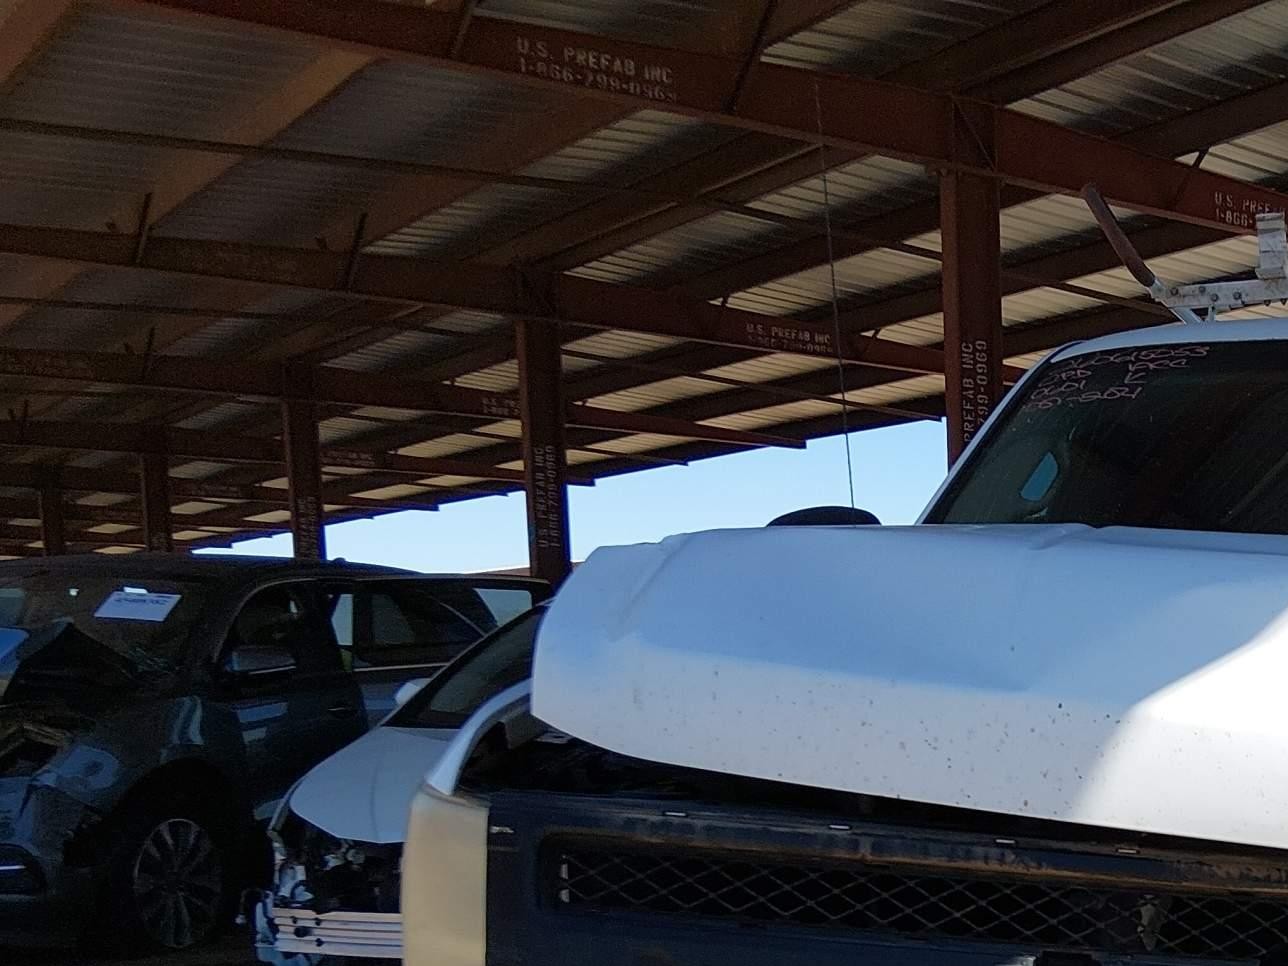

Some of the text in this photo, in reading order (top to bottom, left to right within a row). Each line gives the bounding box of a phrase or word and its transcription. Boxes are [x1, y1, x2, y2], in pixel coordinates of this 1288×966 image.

[516, 36, 553, 60] U.S.
[563, 47, 635, 76] PREFAB
[961, 341, 976, 443] PREFAB INC
